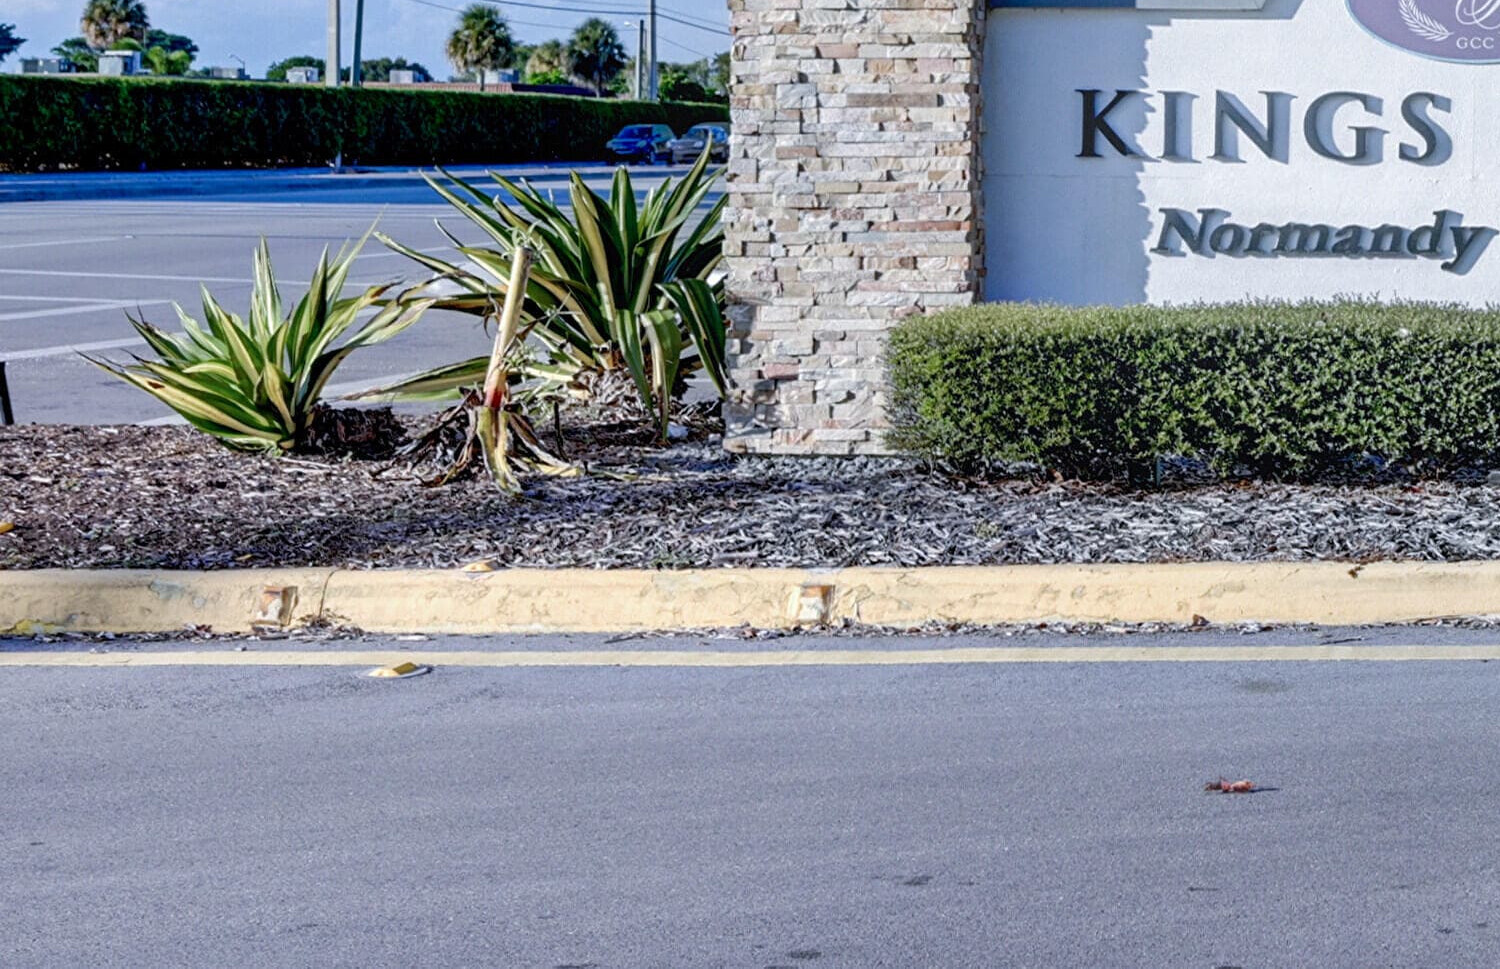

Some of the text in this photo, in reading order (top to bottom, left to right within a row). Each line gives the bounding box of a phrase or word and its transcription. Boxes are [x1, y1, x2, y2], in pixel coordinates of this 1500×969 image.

[1456, 37, 1494, 49] GCC
[1074, 88, 1453, 167] KINGS
[1149, 207, 1499, 275] Normandy
